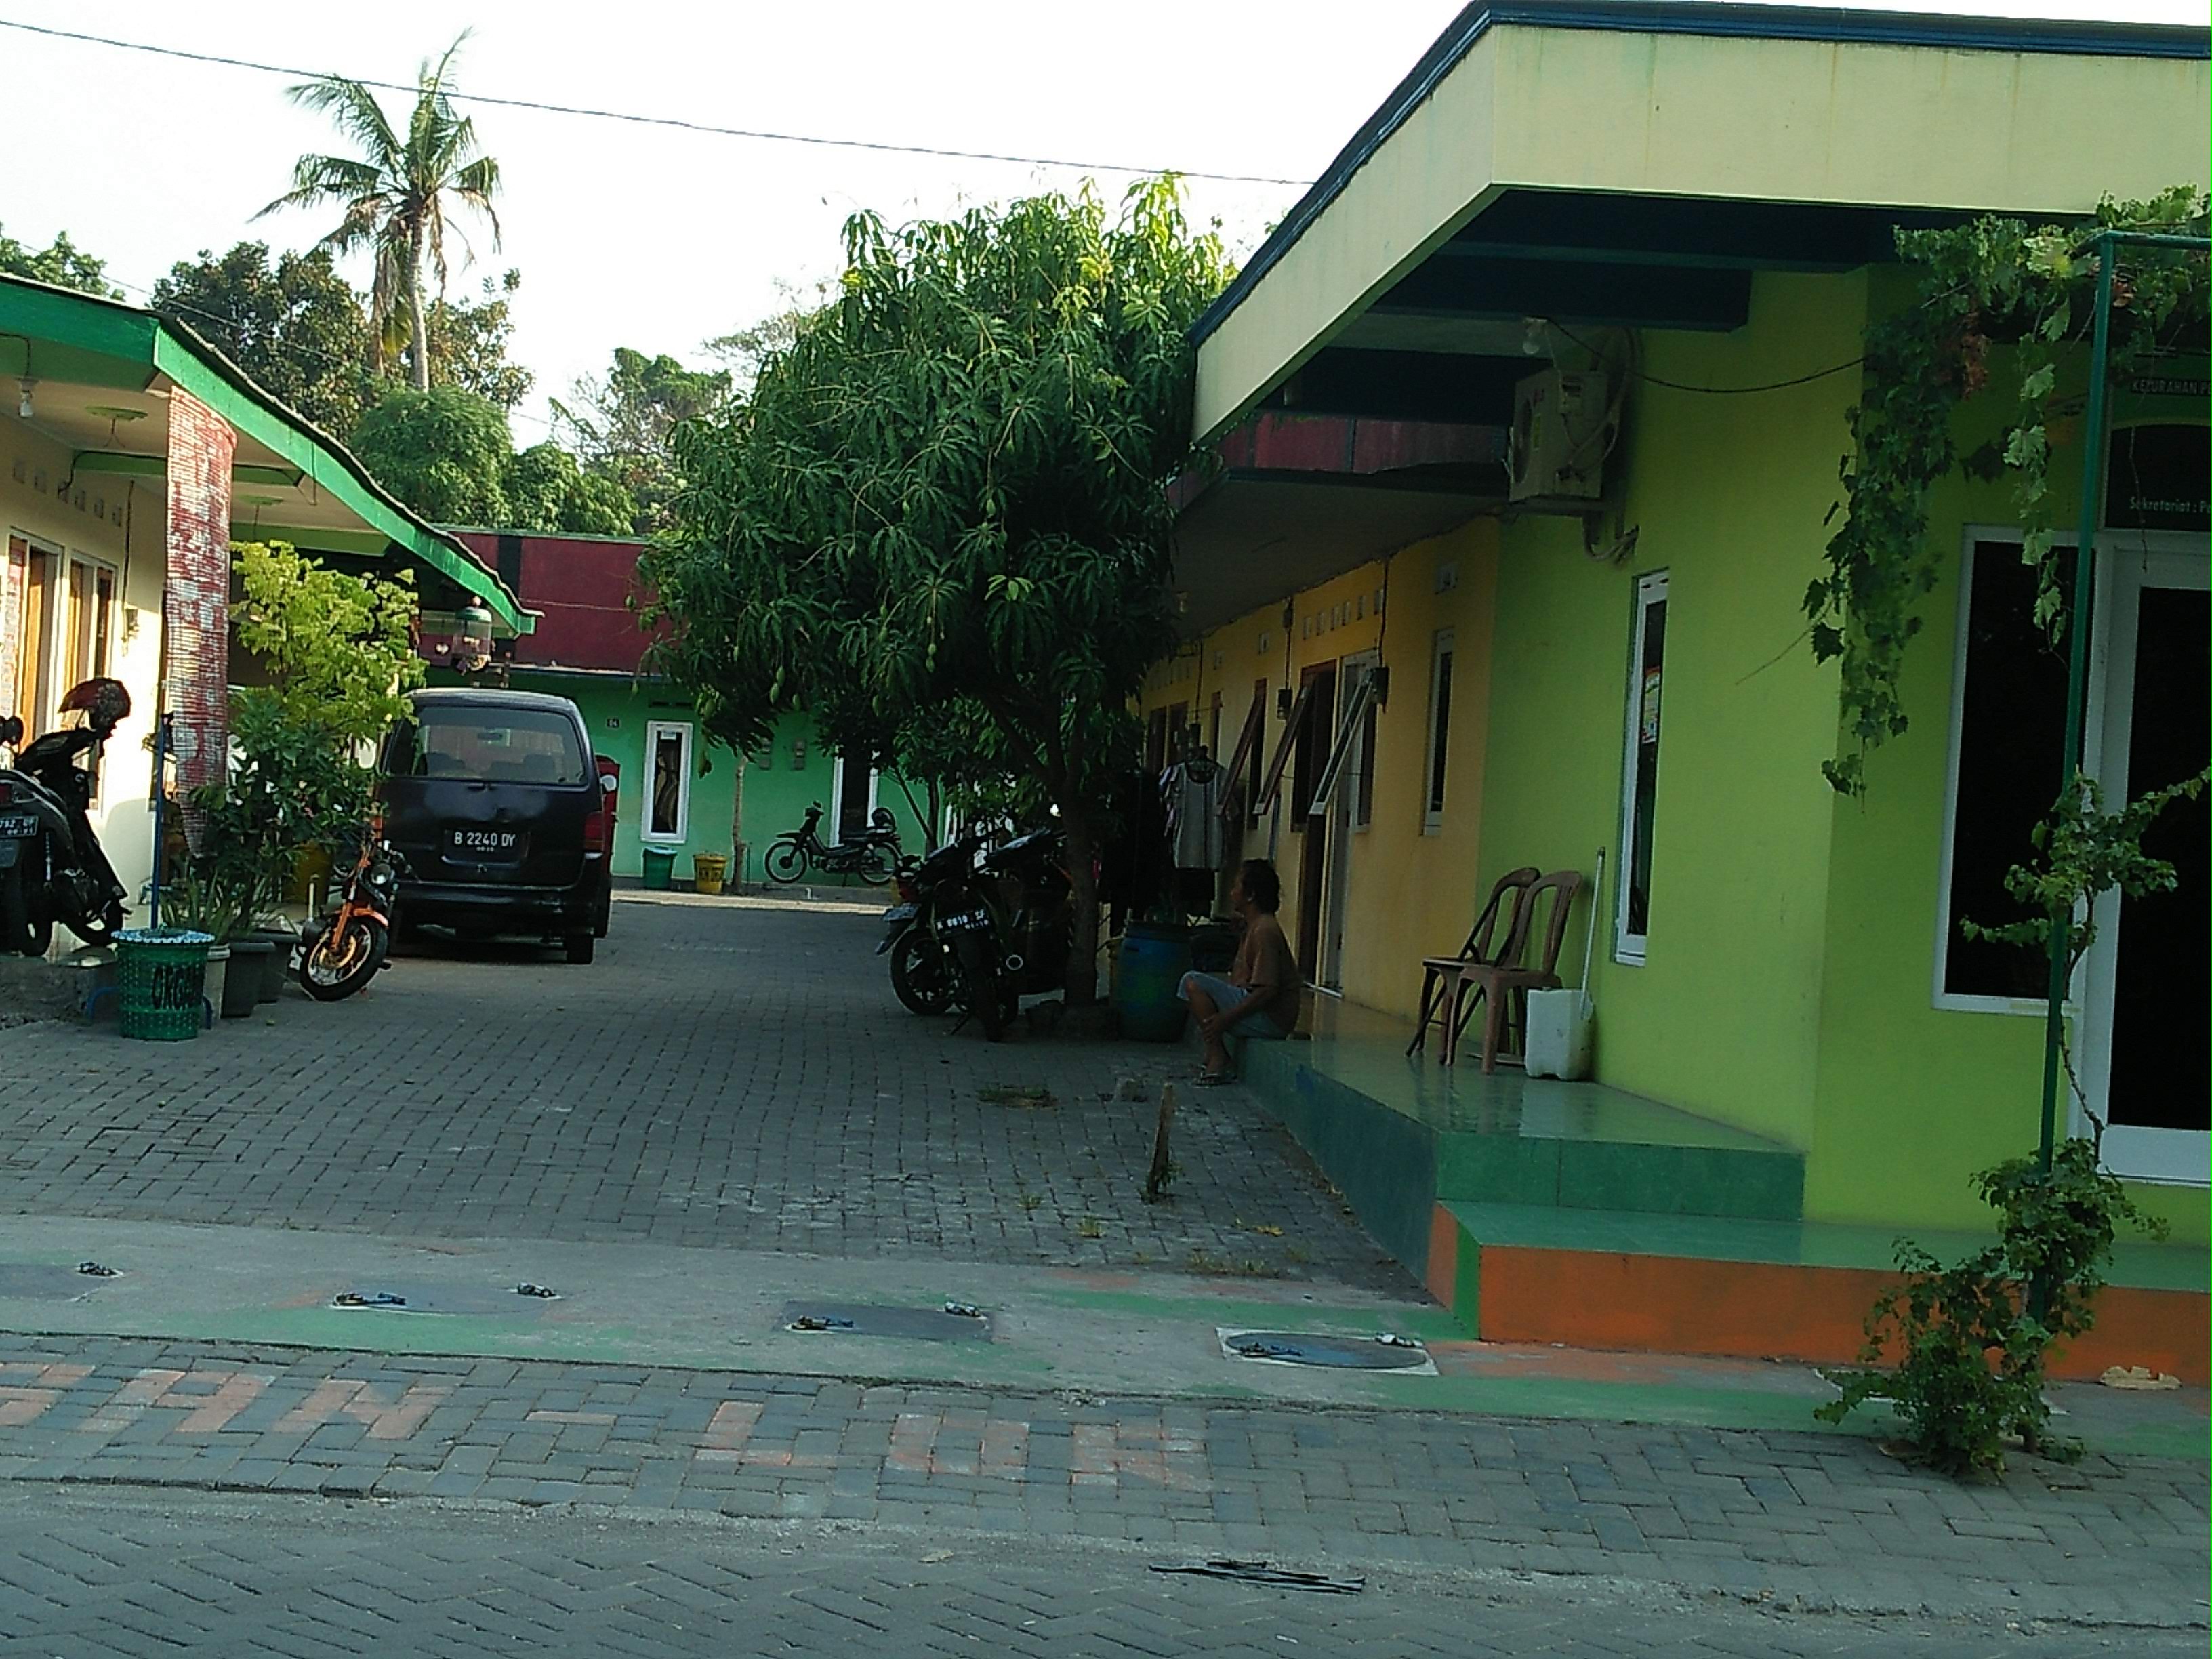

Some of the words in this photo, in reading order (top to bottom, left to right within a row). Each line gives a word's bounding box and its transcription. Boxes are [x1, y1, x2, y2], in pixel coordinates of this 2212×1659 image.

[454, 831, 463, 845] B
[466, 832, 498, 846] 2240
[501, 833, 516, 847] DY
